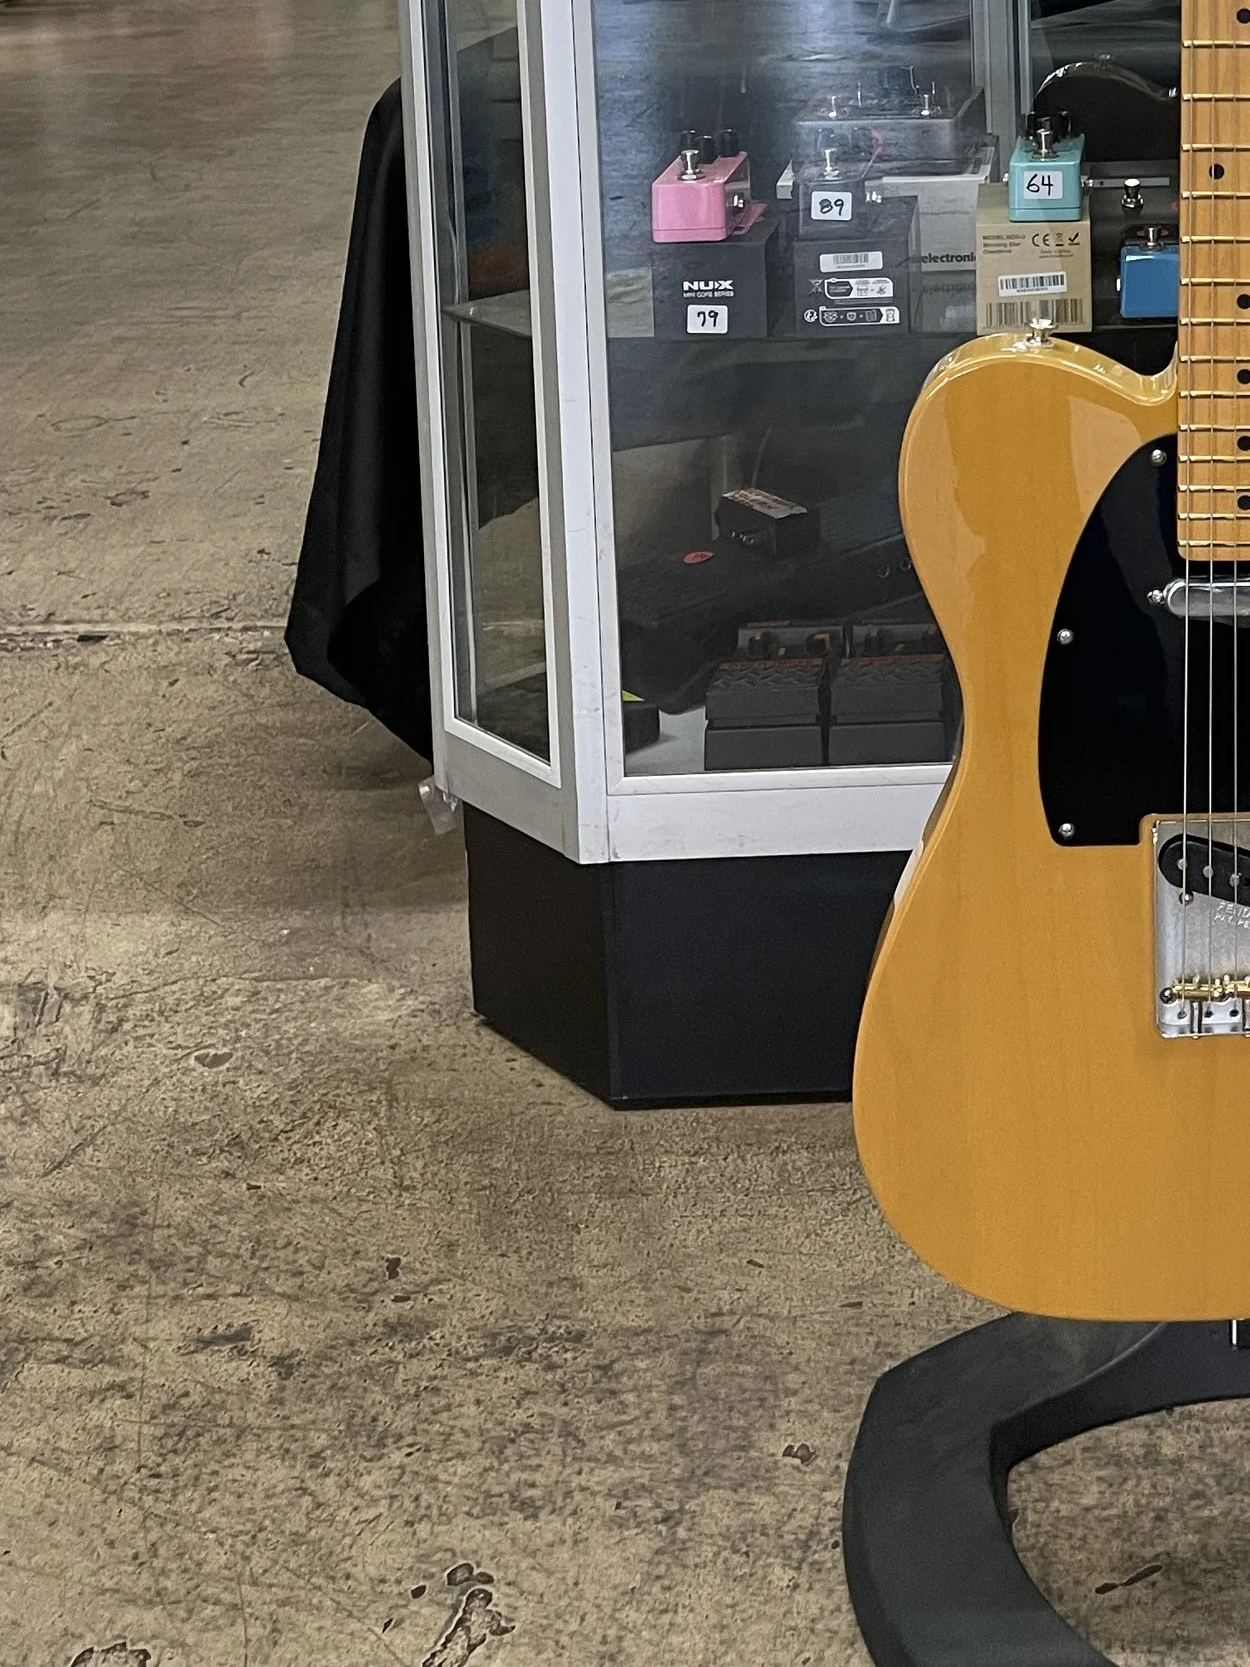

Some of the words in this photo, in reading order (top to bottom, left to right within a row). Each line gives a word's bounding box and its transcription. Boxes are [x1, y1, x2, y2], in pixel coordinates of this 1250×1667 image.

[1026, 173, 1054, 196] 64
[819, 198, 845, 216] 89
[922, 251, 977, 264] electroni
[683, 280, 734, 291] NUX
